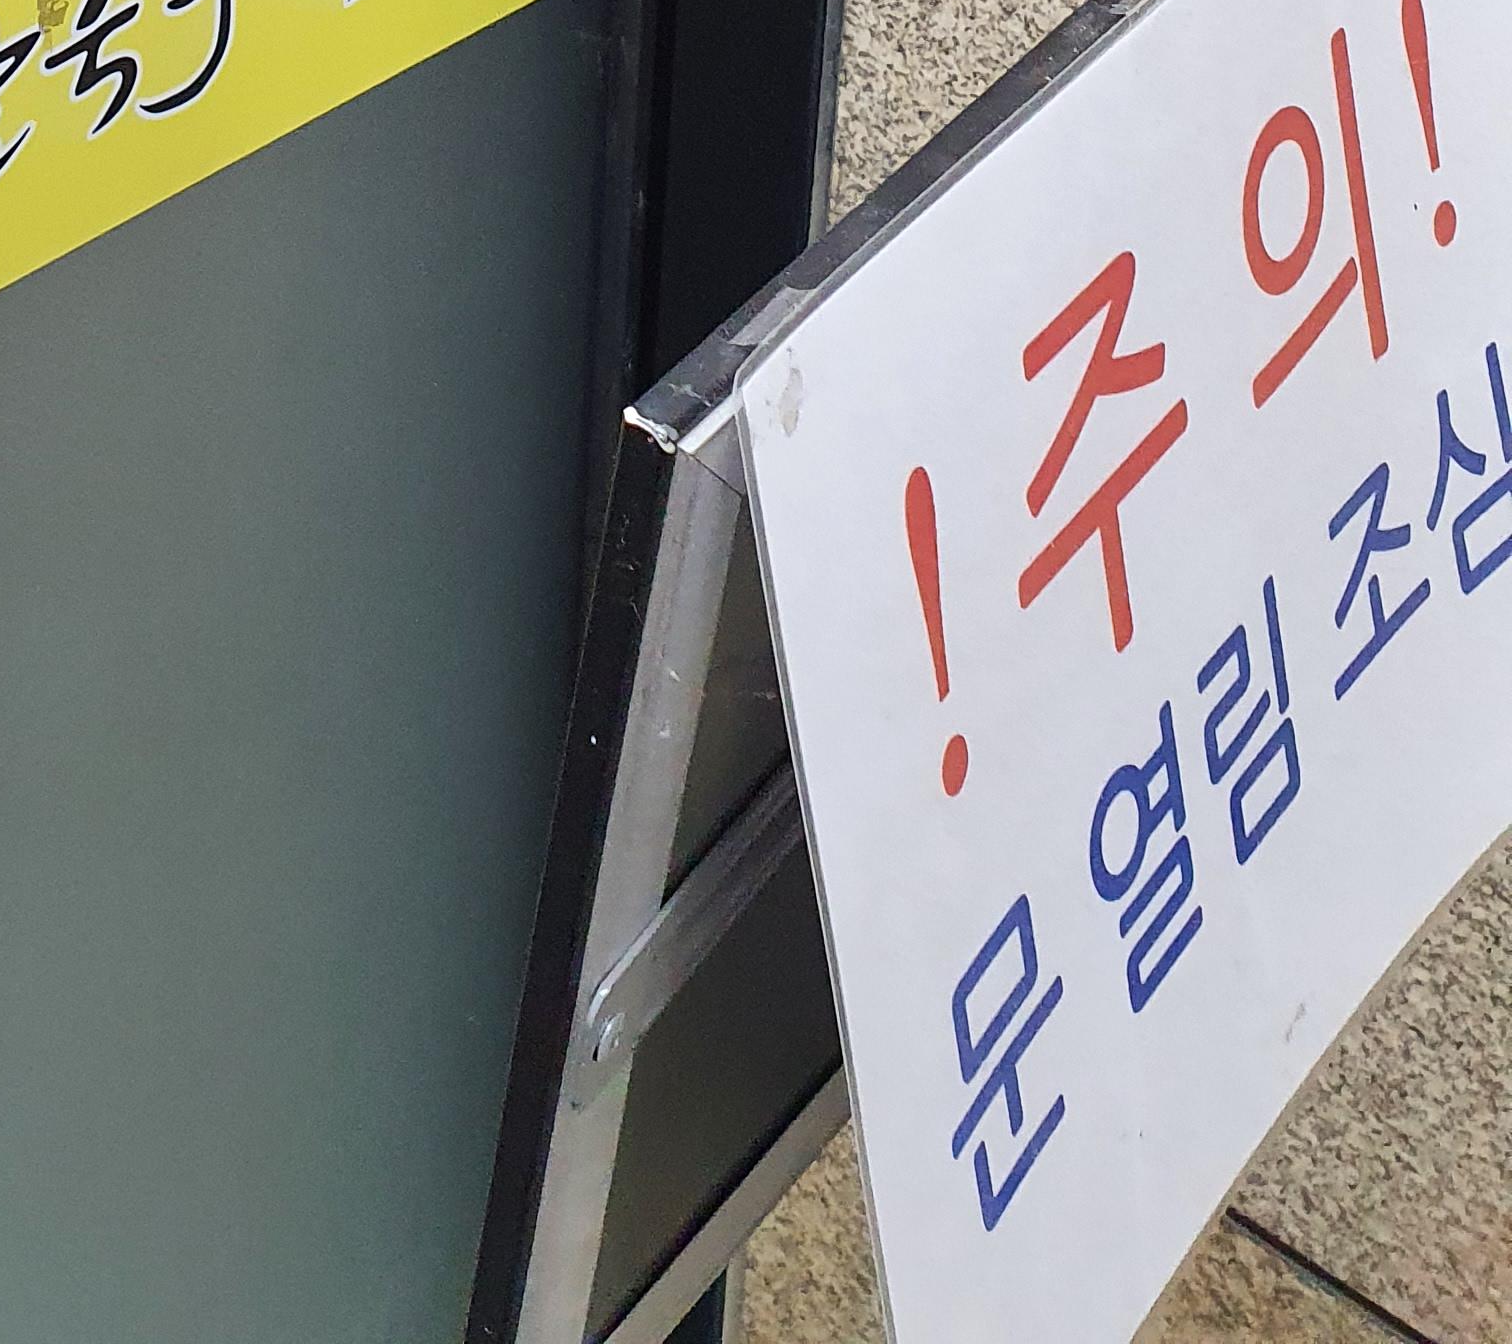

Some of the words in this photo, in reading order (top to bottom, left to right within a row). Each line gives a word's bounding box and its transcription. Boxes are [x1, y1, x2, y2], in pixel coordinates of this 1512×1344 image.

[952, 893, 1065, 1233] 문
[1089, 576, 1301, 1013] 열림
[1329, 342, 1512, 700] 조심
